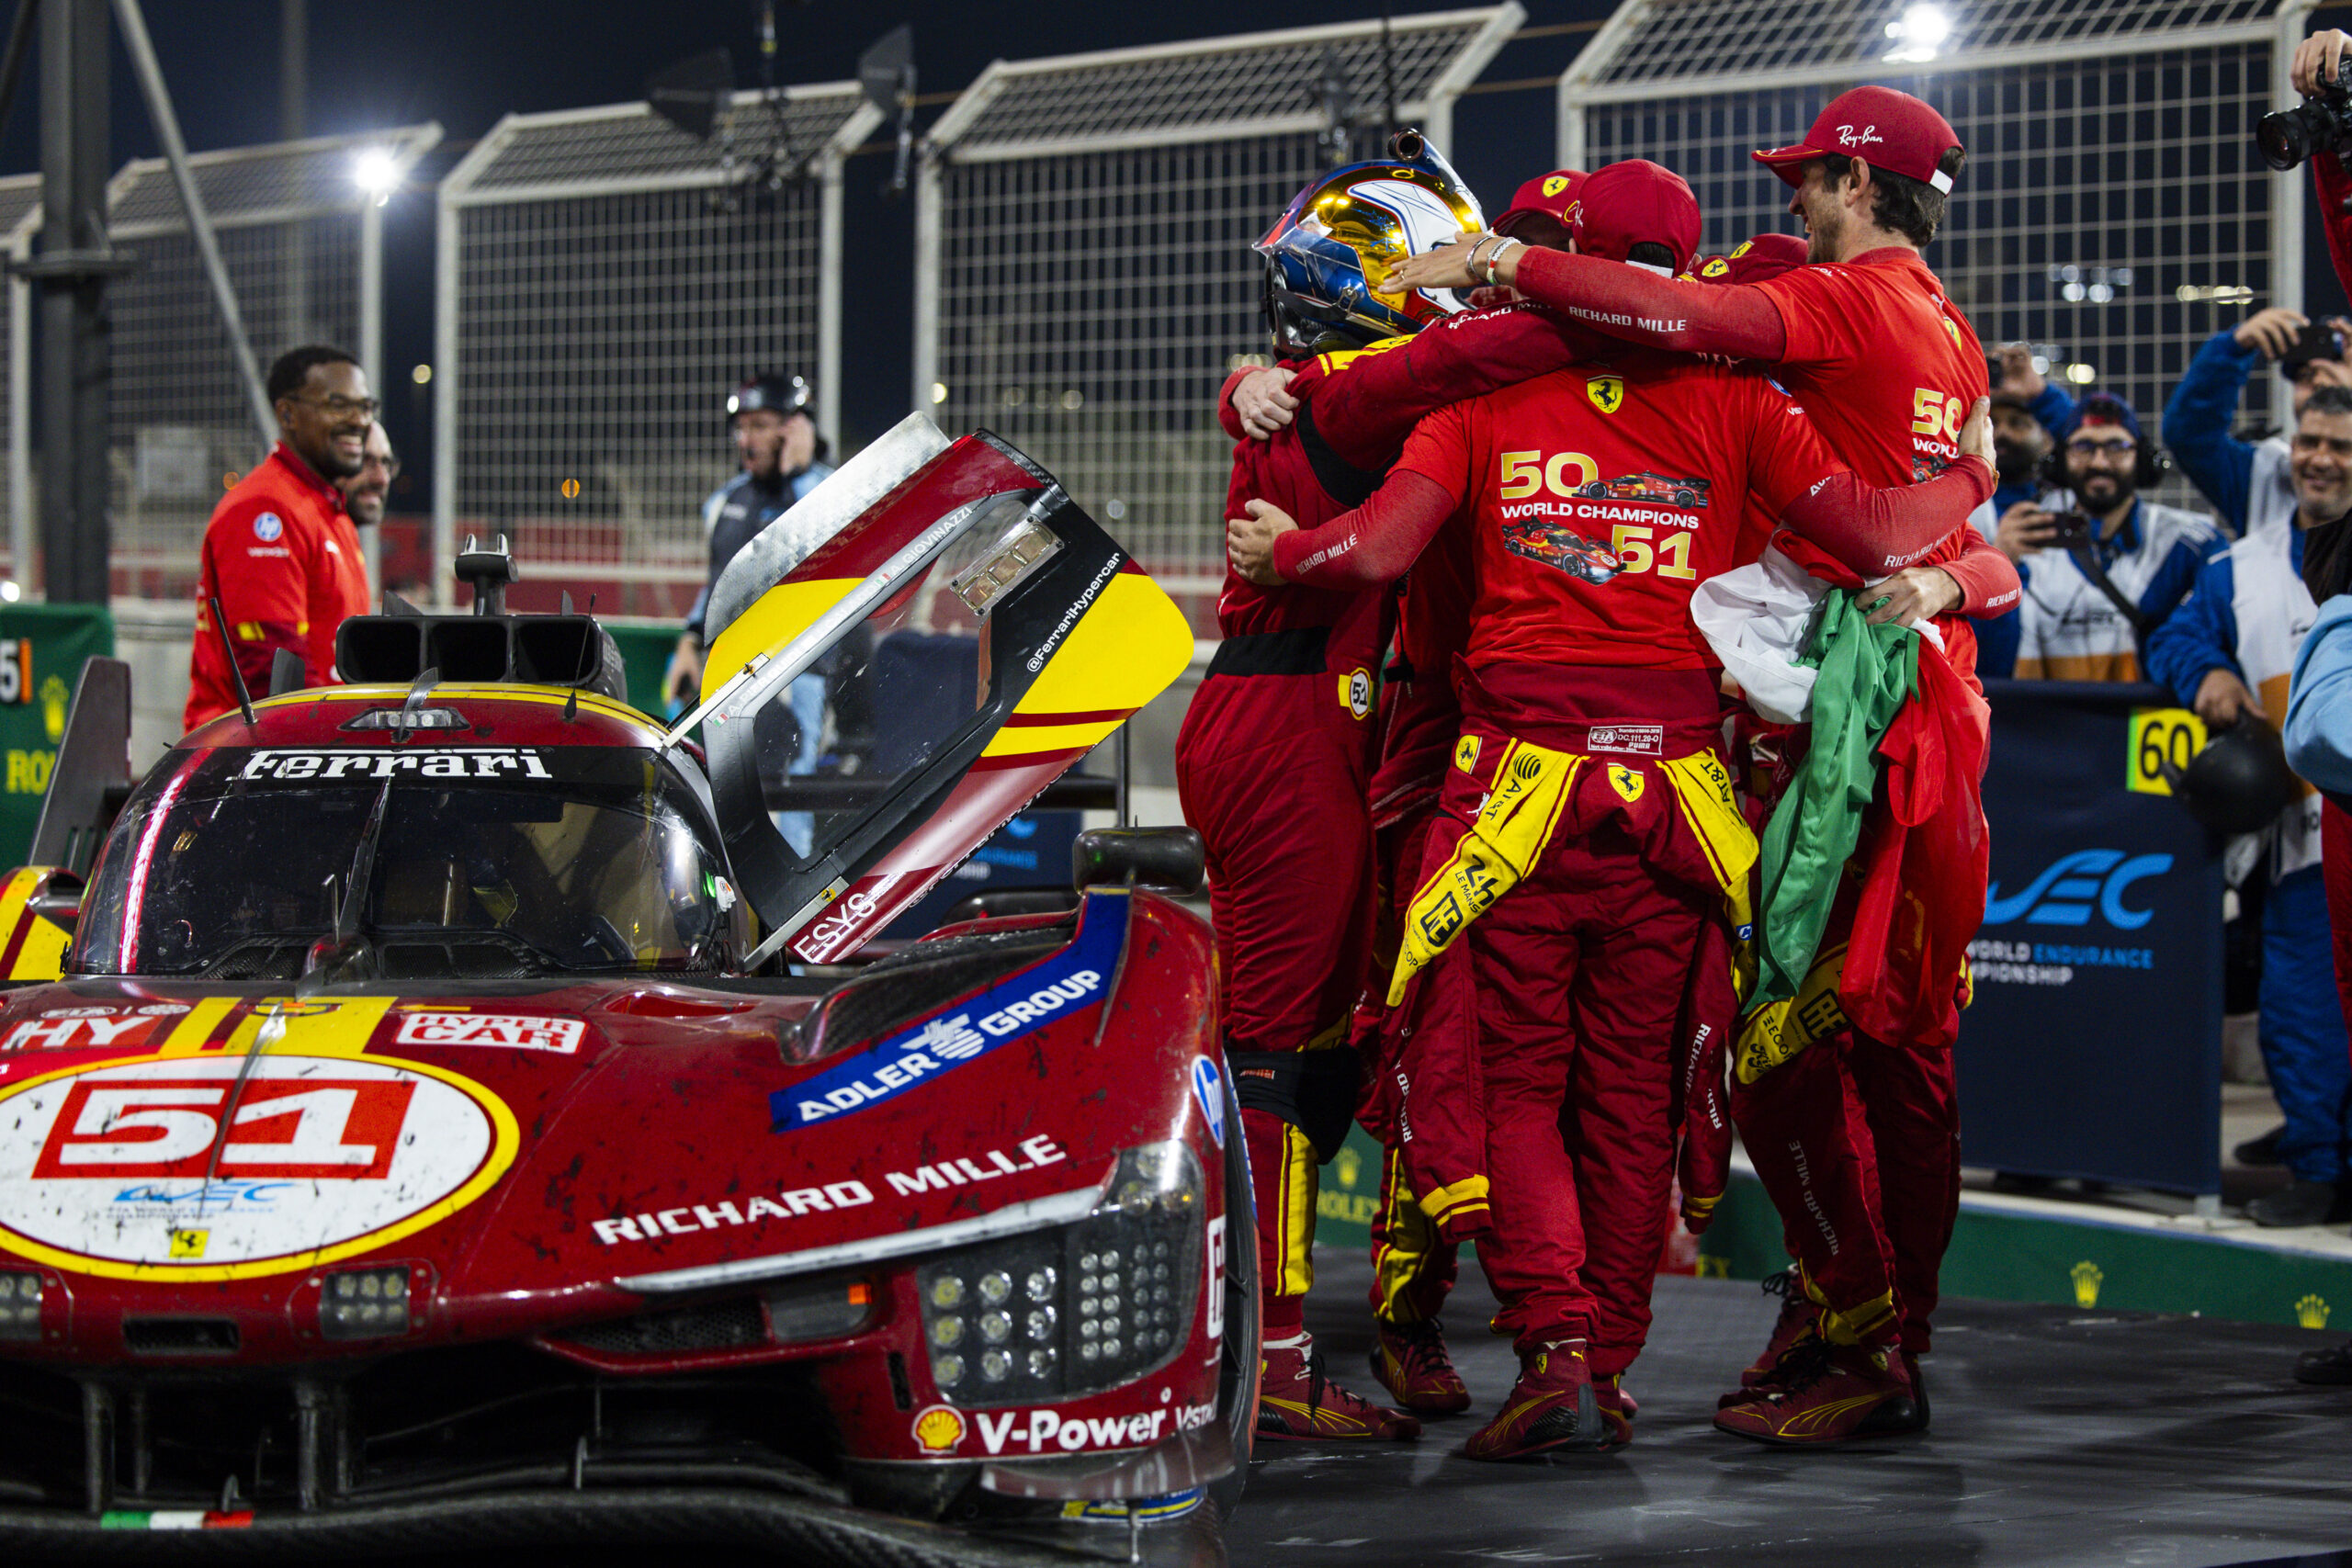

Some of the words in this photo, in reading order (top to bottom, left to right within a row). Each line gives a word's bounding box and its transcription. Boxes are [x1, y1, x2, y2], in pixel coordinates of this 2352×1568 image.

[1568, 306, 1632, 326] RICHARD
[1637, 317, 1687, 333] MILLE
[1501, 450, 1599, 500] 50
[903, 506, 973, 561] GIOVINAZZI
[1501, 502, 1573, 519] WORLD
[1577, 505, 1700, 529] CHAMPIONS
[1327, 533, 1358, 559] MILLE
[1610, 524, 1696, 581] 51
[1884, 542, 1933, 568] RICHARD
[1027, 552, 1120, 671] @FerrariHypercar
[1985, 591, 2018, 608] RICHARD
[1352, 682, 1368, 705] 51
[225, 749, 553, 781] Ferrari
[2141, 720, 2193, 780] 60
[1700, 761, 1731, 802] AT&T
[1455, 871, 1466, 884] LE
[1461, 883, 1481, 913] MANS
[2033, 943, 2154, 969] ENDURANCE
[412, 1025, 566, 1047] CAR
[418, 1017, 571, 1031] HYPER
[797, 1053, 941, 1122] ADLER
[978, 970, 1102, 1036] GROUP
[60, 1088, 377, 1166] 51
[1788, 1140, 1811, 1187] MILLE
[593, 1179, 875, 1245] RICHARD
[885, 1134, 1068, 1196] MILLE
[1804, 1190, 1839, 1257] RICHARD
[976, 1409, 1167, 1455] V-Power
